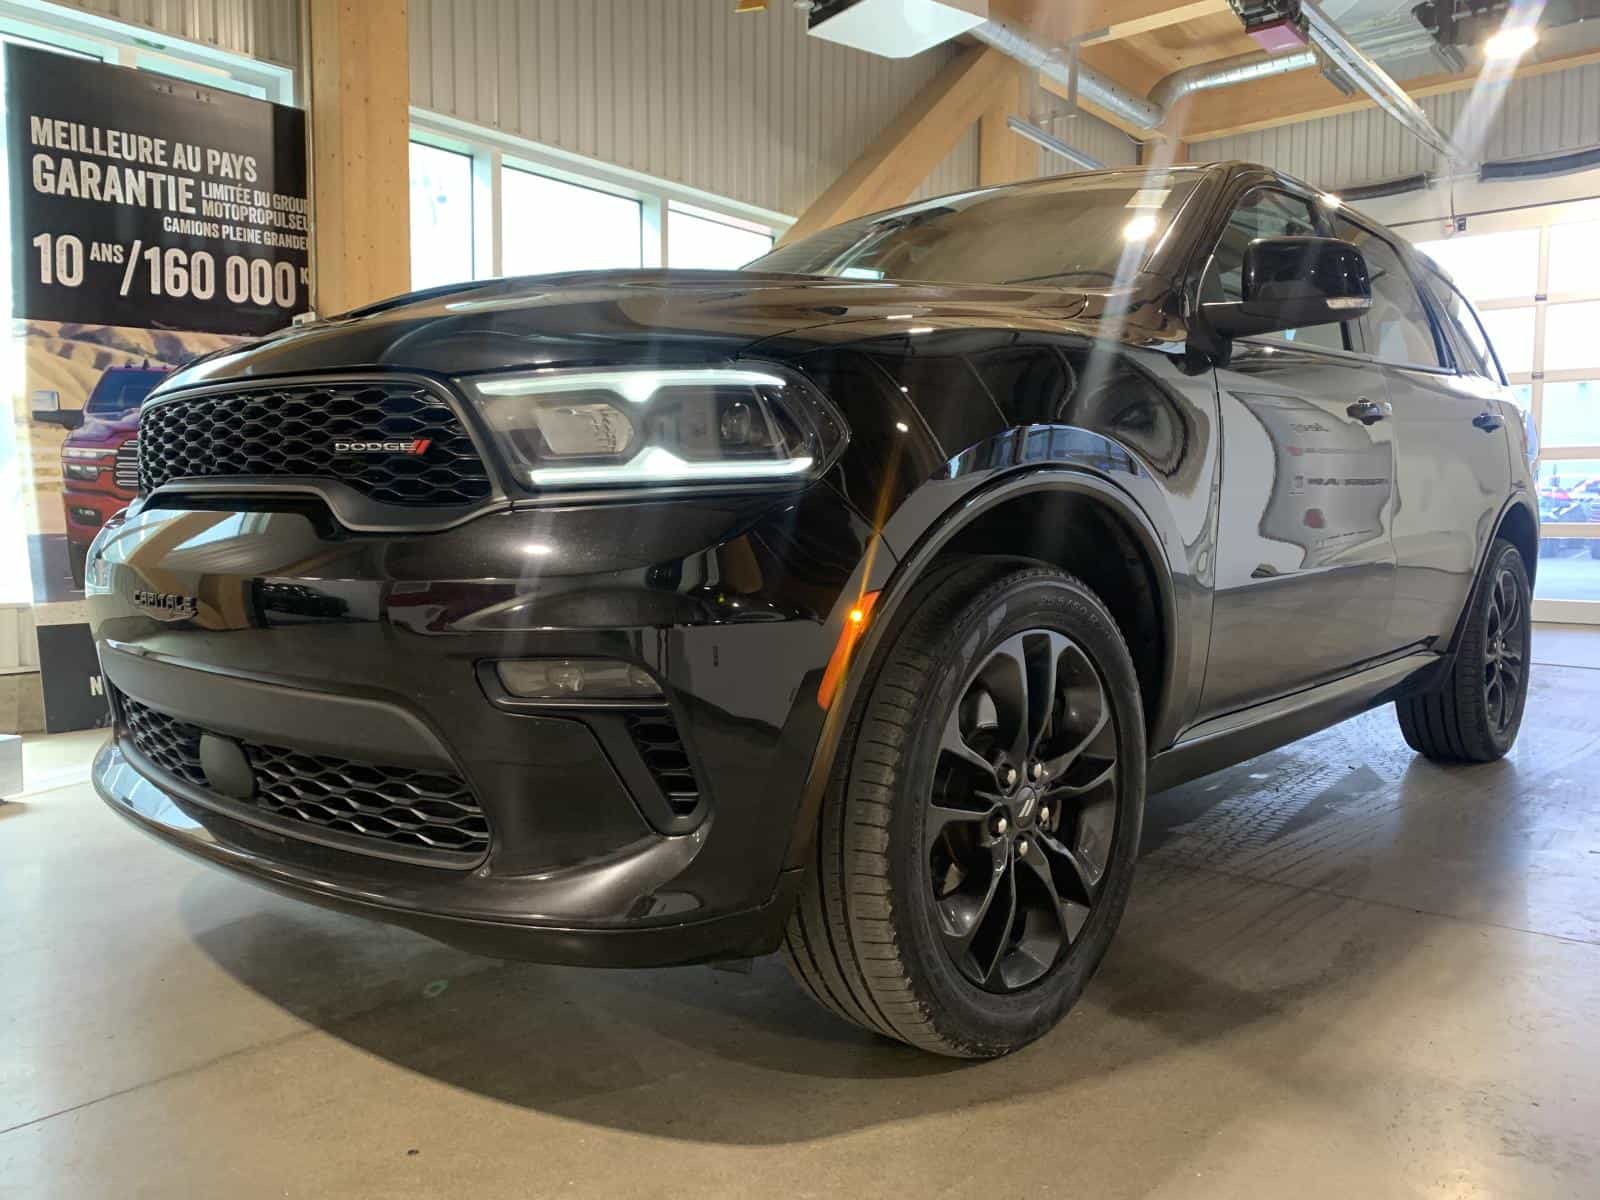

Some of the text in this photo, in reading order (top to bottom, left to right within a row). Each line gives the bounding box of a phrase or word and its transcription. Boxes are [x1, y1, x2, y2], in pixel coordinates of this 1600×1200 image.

[30, 115, 258, 183] MEILLEURE AU PAYS
[32, 153, 197, 215] GARANTIE
[201, 180, 252, 206] LIMITÉE
[253, 190, 272, 209] DU
[163, 215, 220, 240] CAMIONS
[221, 224, 262, 245] PLEINE
[32, 232, 84, 288] 10
[90, 241, 124, 264] ANS
[225, 254, 296, 309] 000
[335, 442, 417, 452] DODGE
[133, 591, 195, 611] CAPITALE
